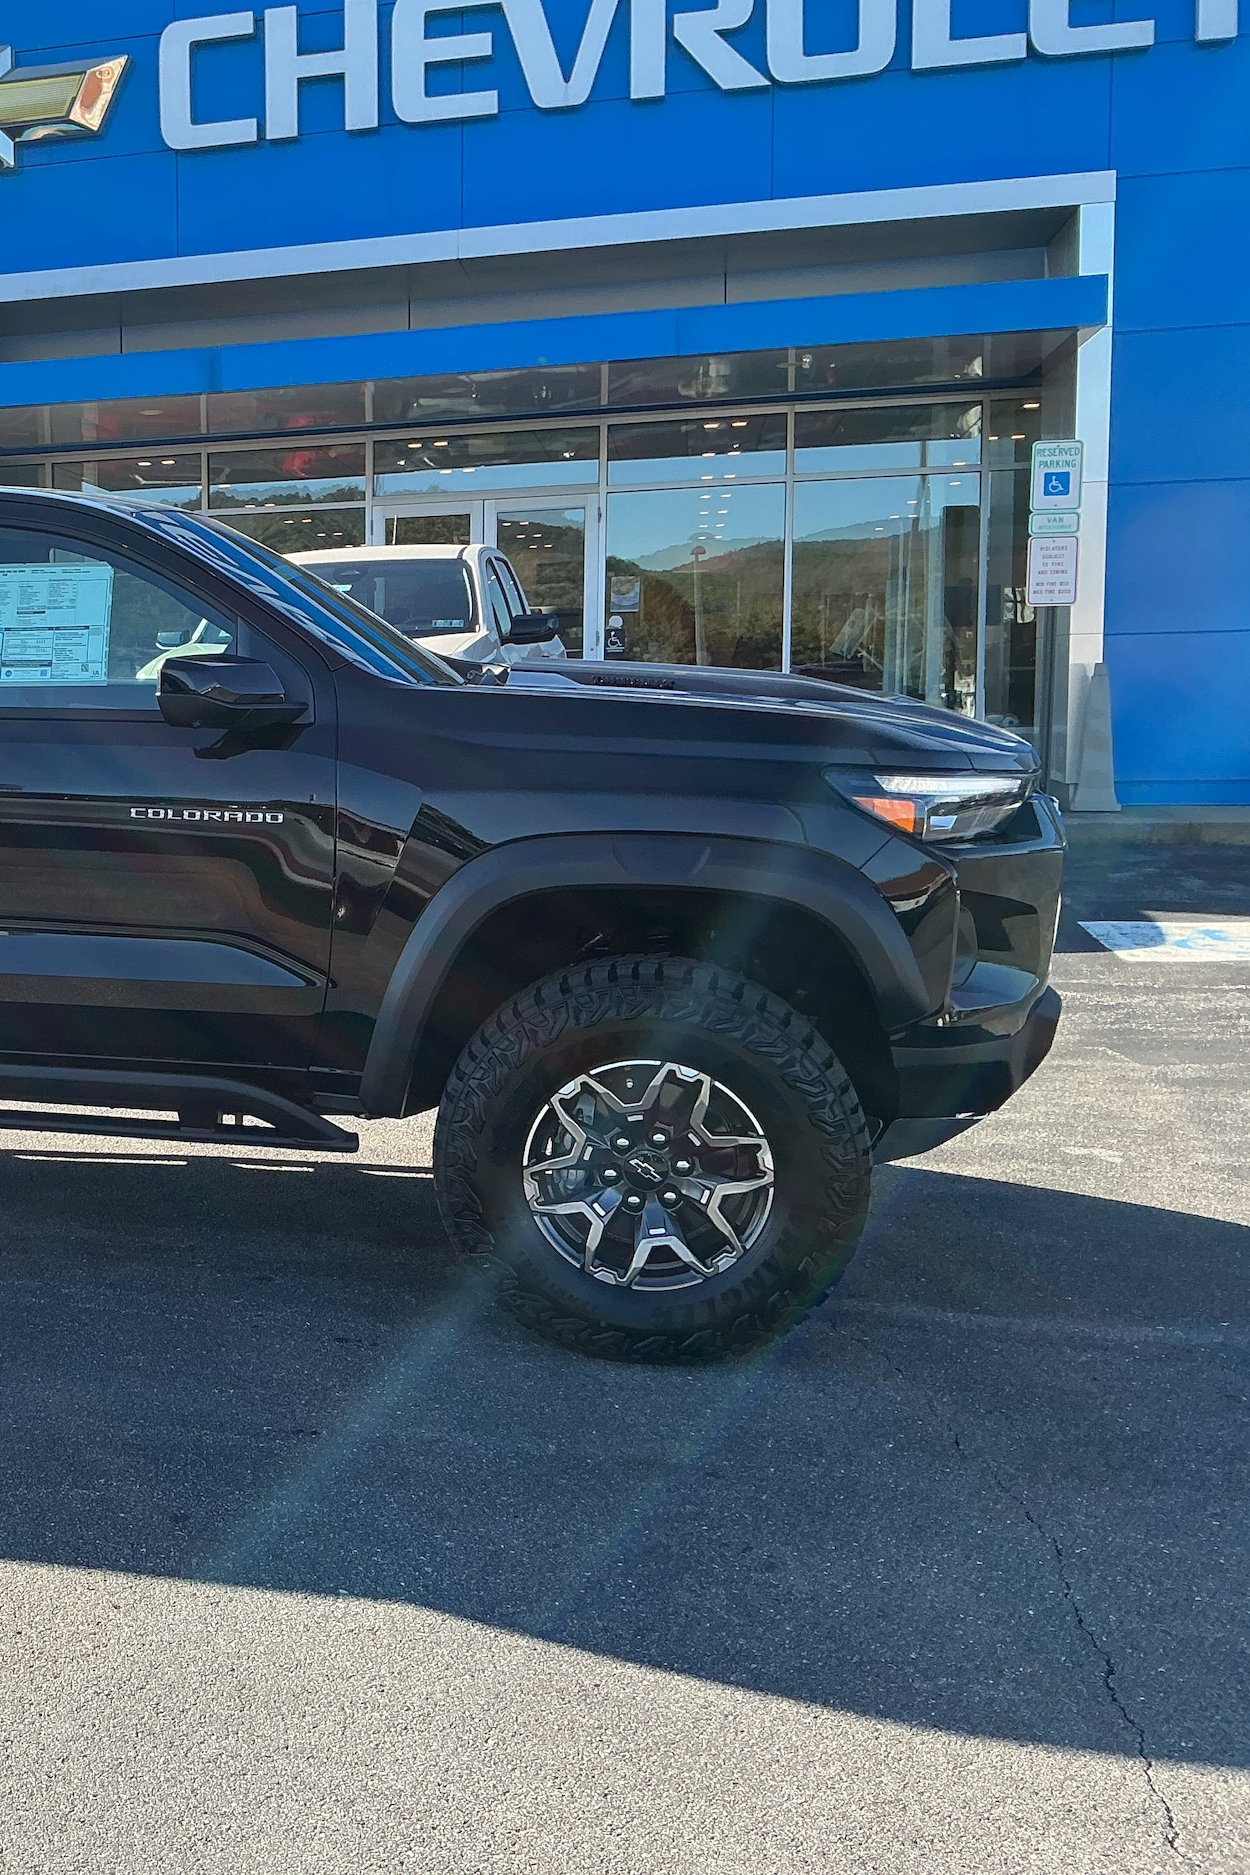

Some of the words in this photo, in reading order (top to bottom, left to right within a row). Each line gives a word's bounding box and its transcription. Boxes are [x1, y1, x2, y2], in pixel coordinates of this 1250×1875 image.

[1036, 447, 1080, 458] RESERVED
[1038, 459, 1077, 469] PARKING
[1047, 516, 1064, 524] VAN
[129, 807, 285, 824] COLORADO
